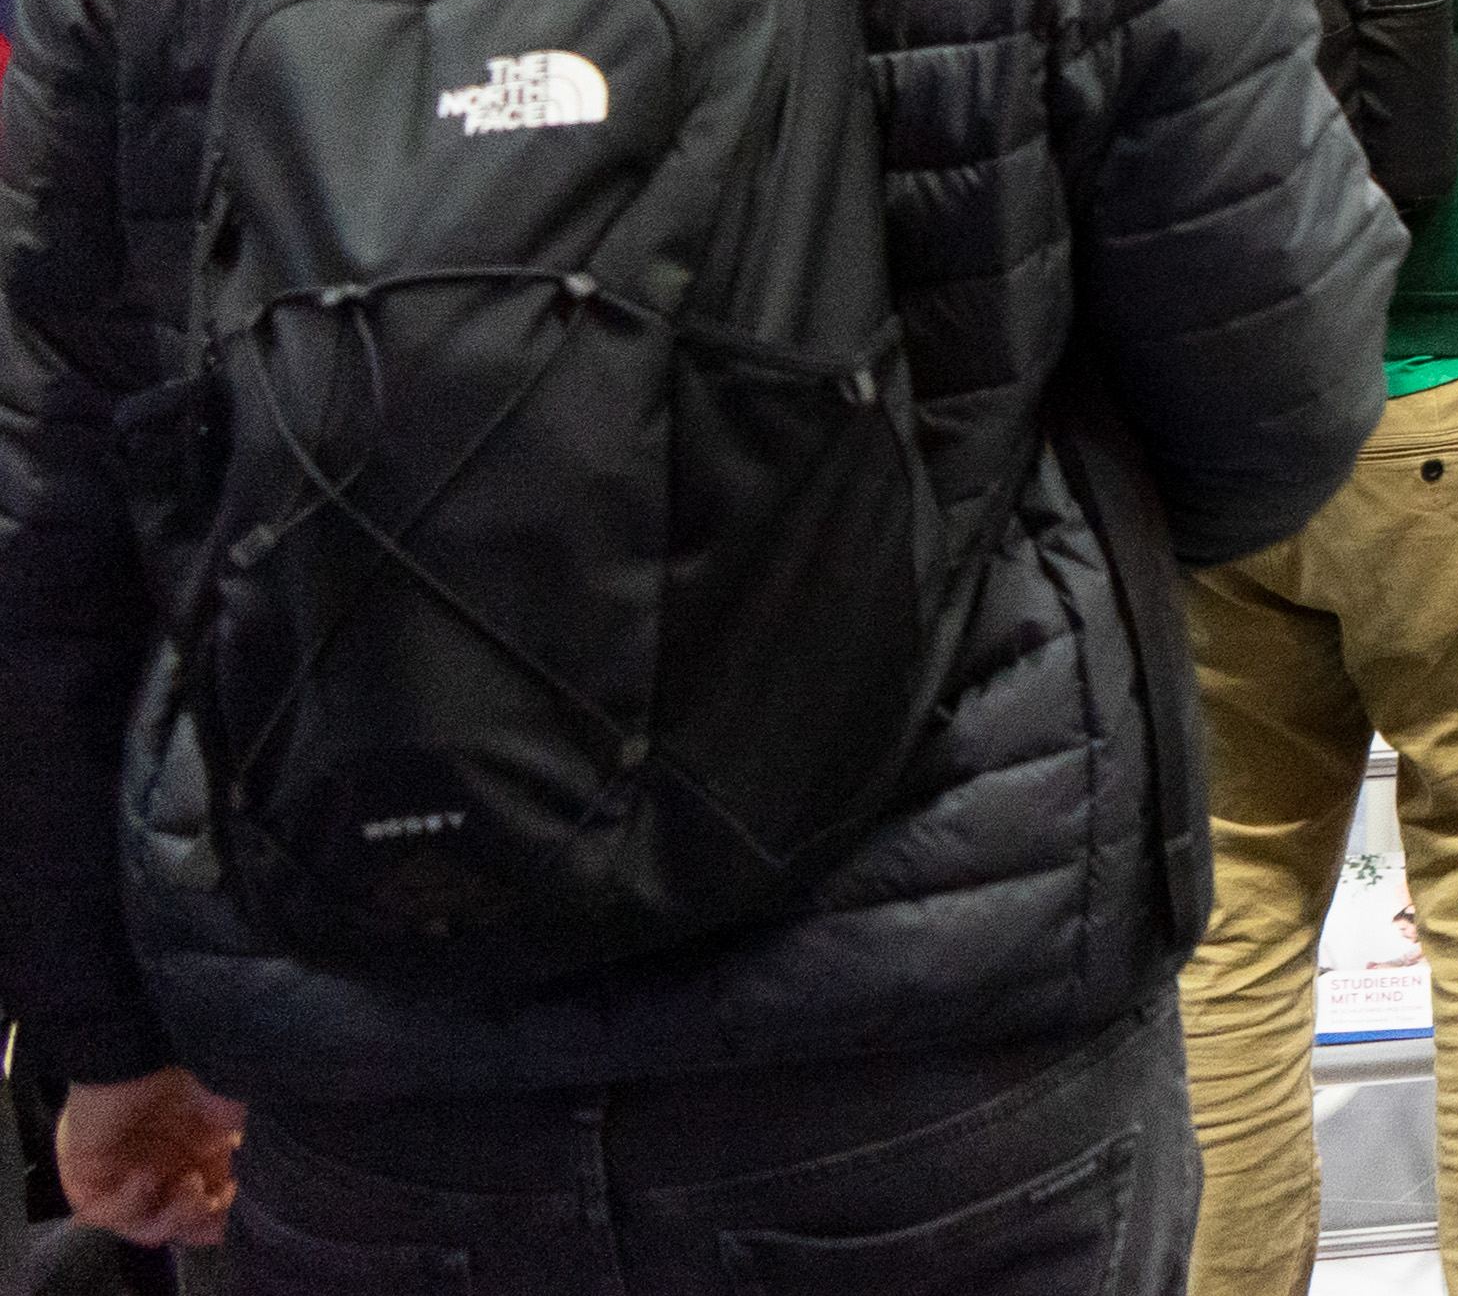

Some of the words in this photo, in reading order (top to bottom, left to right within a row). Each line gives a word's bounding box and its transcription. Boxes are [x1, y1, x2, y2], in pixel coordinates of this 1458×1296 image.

[487, 54, 548, 84] THE
[1331, 976, 1422, 991] STUDIEREN
[1331, 992, 1359, 1004] MIT
[1365, 990, 1404, 1002] KIND
